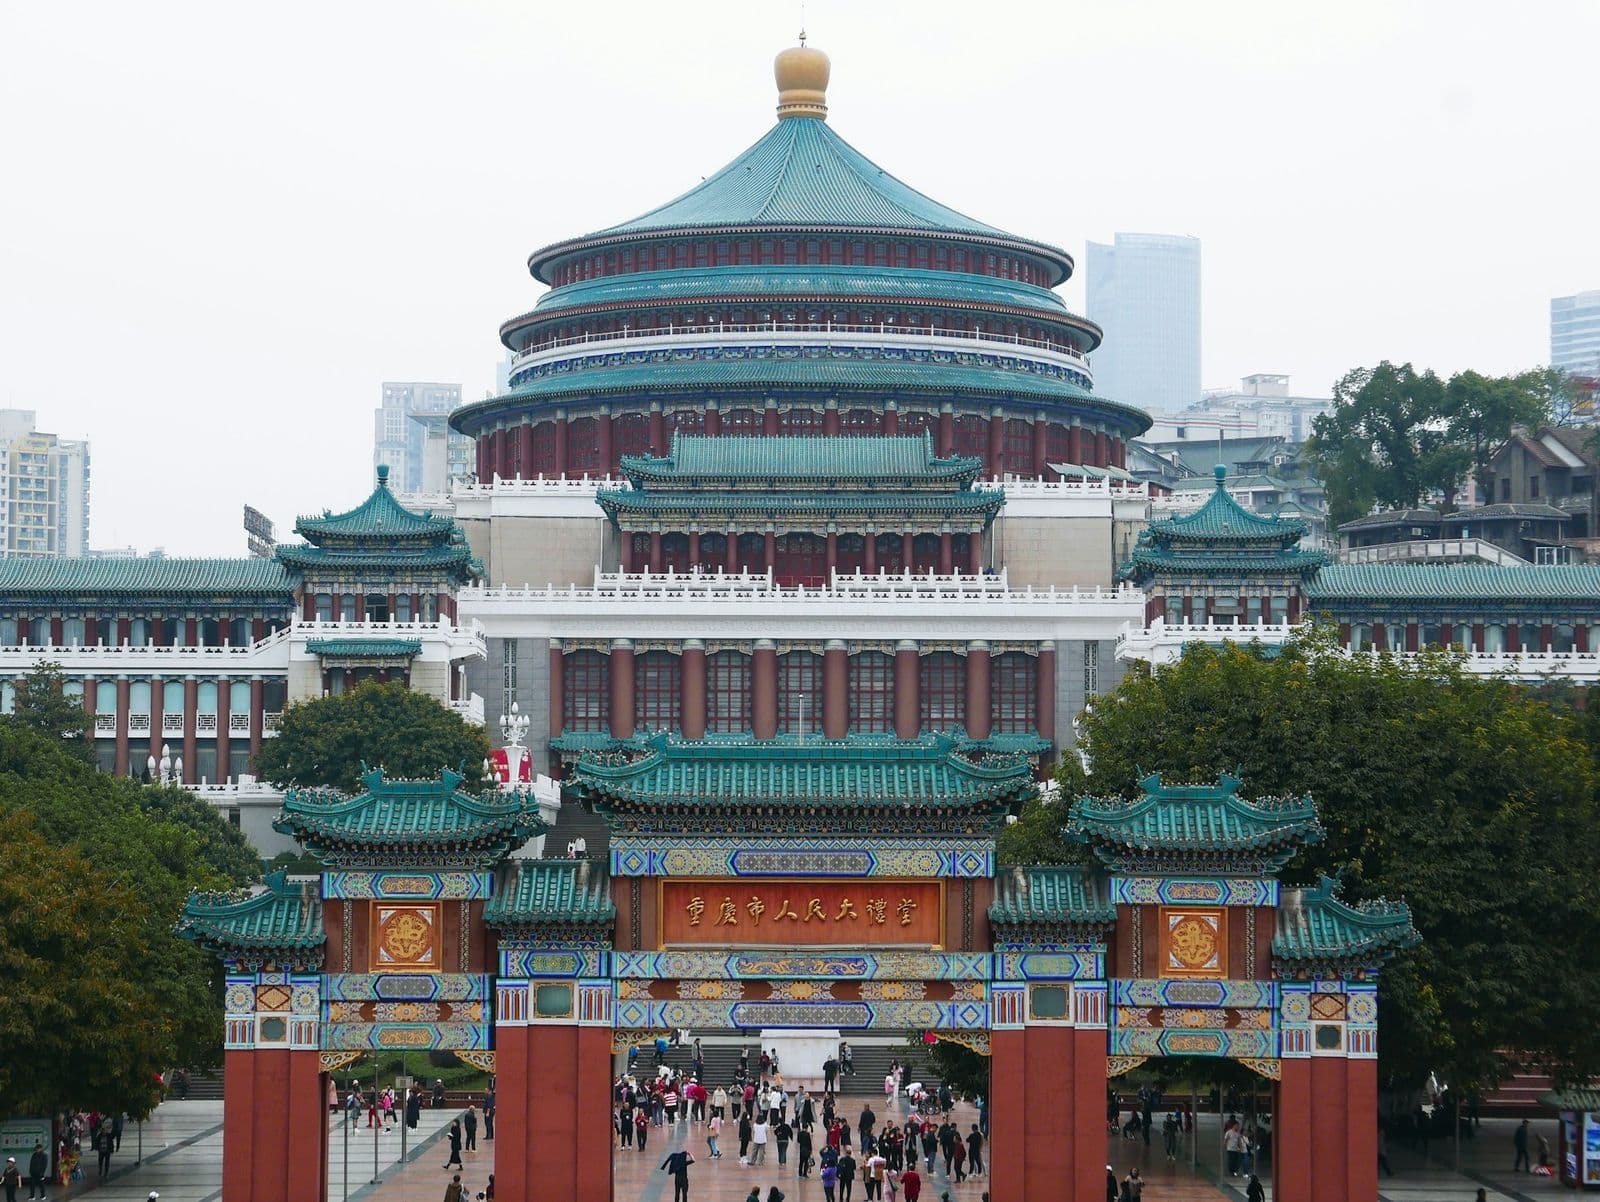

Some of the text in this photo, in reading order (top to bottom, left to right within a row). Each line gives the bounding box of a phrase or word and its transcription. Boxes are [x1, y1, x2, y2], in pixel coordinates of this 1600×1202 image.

[686, 896, 917, 927] 重慶市人民大禮堂
